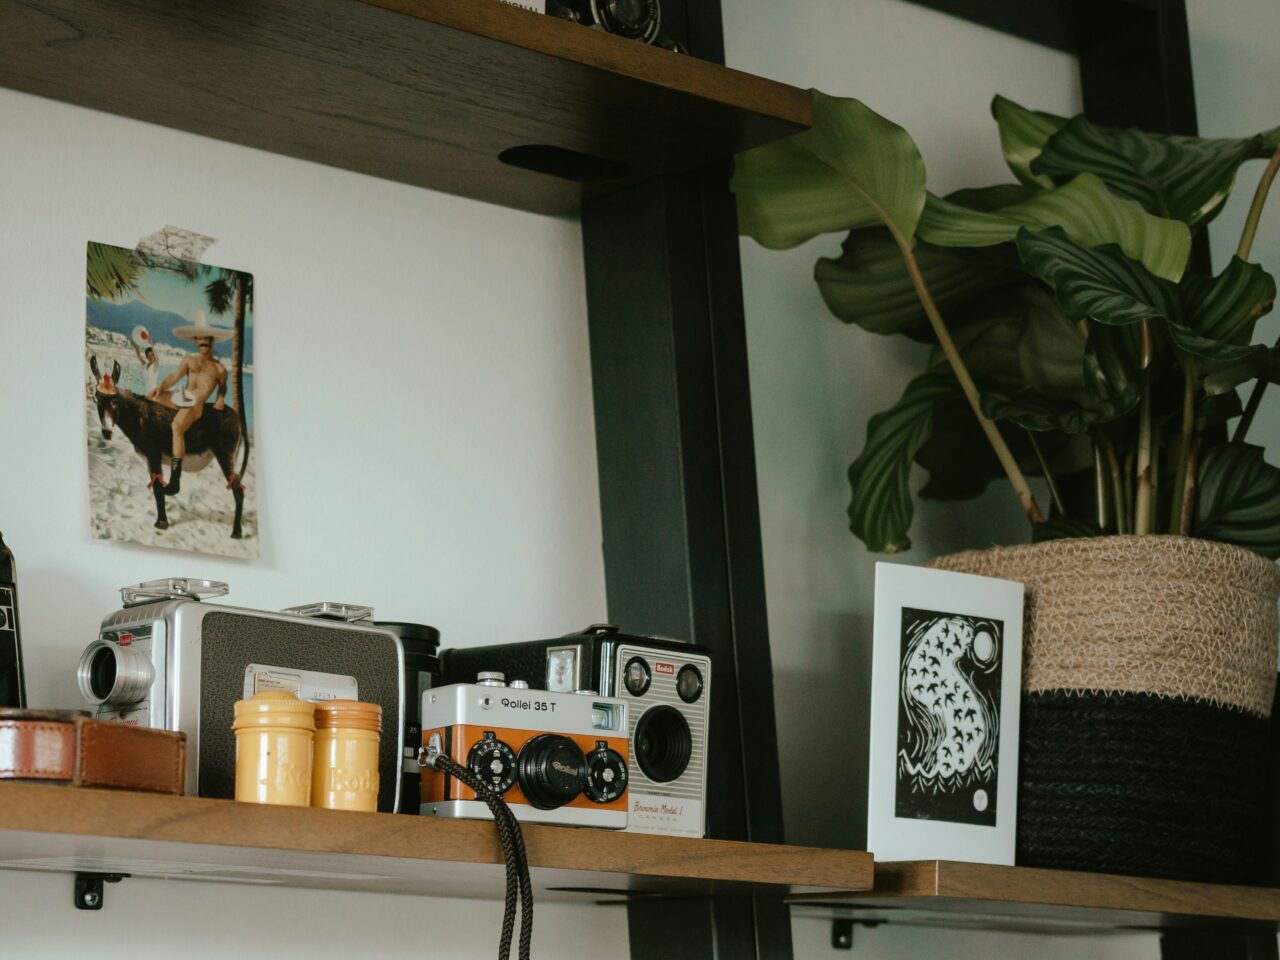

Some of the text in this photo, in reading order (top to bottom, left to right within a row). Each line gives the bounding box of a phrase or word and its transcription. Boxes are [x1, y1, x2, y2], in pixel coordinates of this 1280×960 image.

[656, 664, 673, 673] Kodak
[501, 698, 556, 712] Rollei 35 T
[552, 761, 578, 776] Rollei
[633, 801, 658, 813] Brownie
